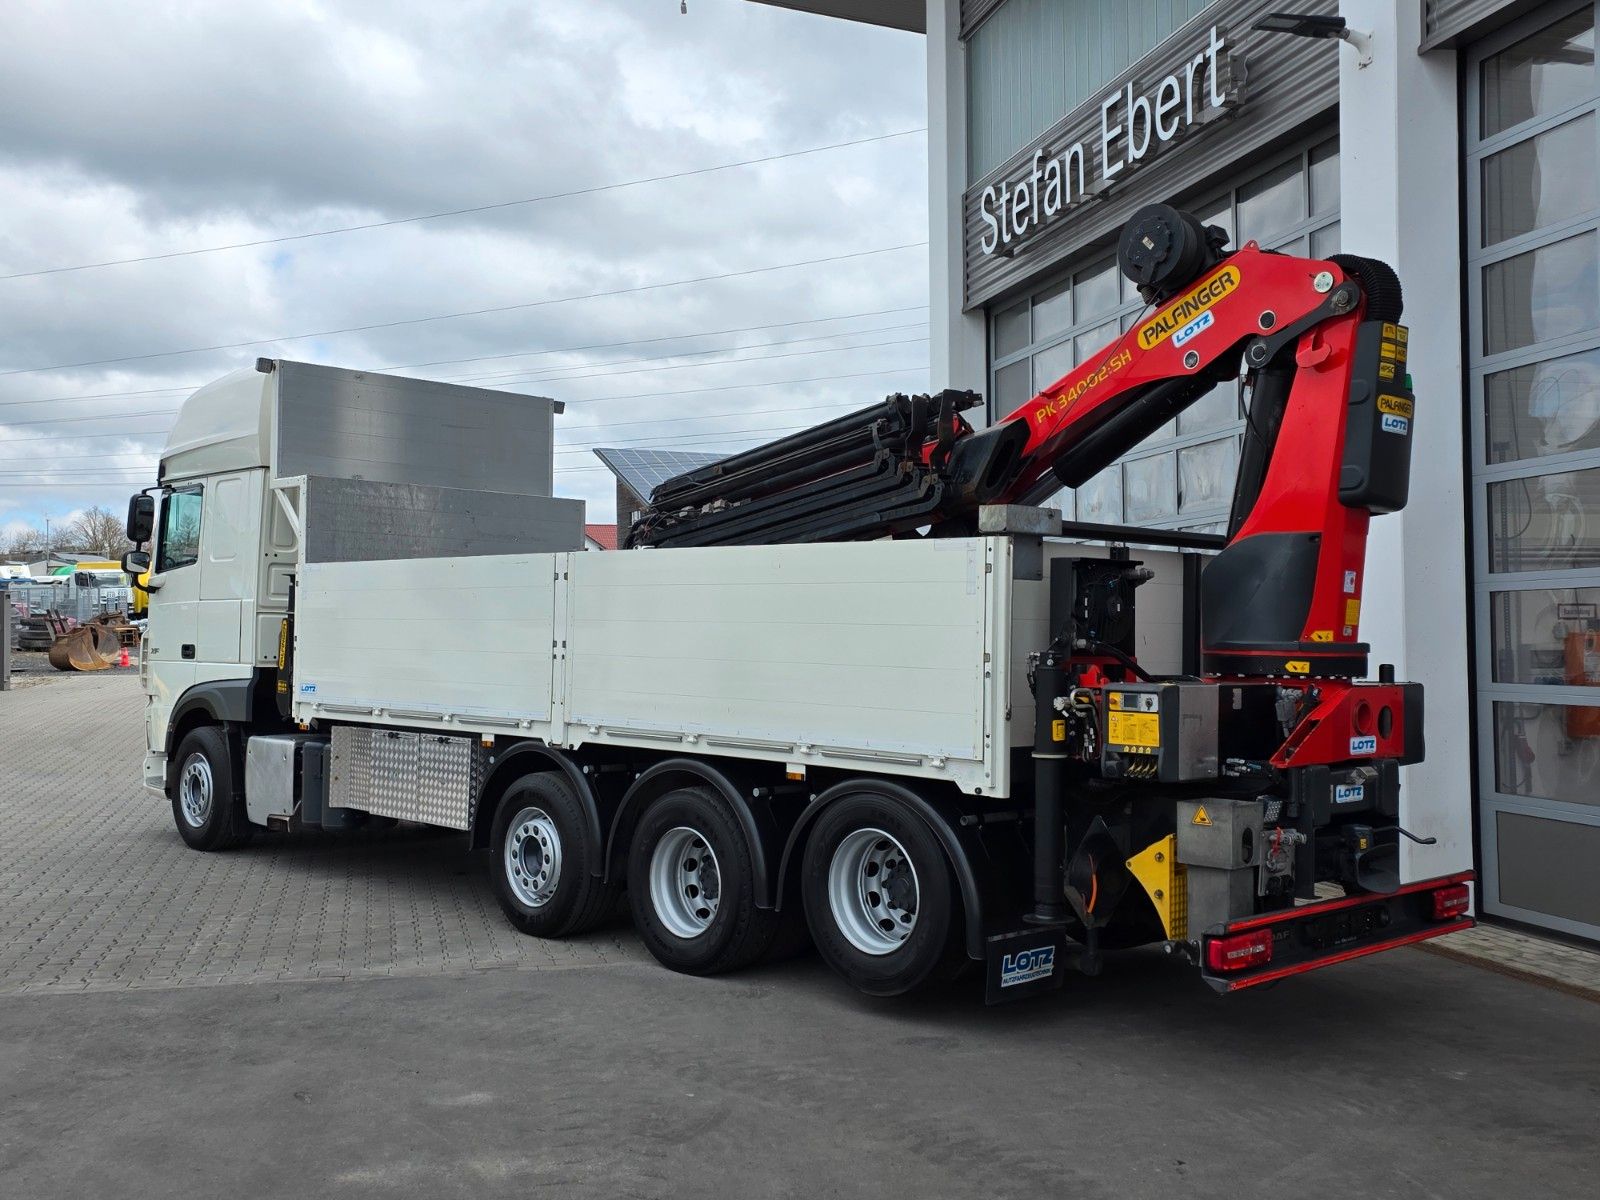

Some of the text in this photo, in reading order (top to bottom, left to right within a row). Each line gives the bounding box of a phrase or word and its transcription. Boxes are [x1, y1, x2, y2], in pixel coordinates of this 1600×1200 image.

[980, 25, 1226, 255] Stefan Ebert
[1142, 270, 1236, 346] PALFINGER
[1175, 313, 1211, 344] LOTZ
[1035, 402, 1057, 424] PK
[1384, 417, 1407, 430] LOTZ
[1352, 740, 1375, 750] LOTZ
[1338, 787, 1362, 798] LOTZ
[1002, 946, 1055, 975] LOTZ
